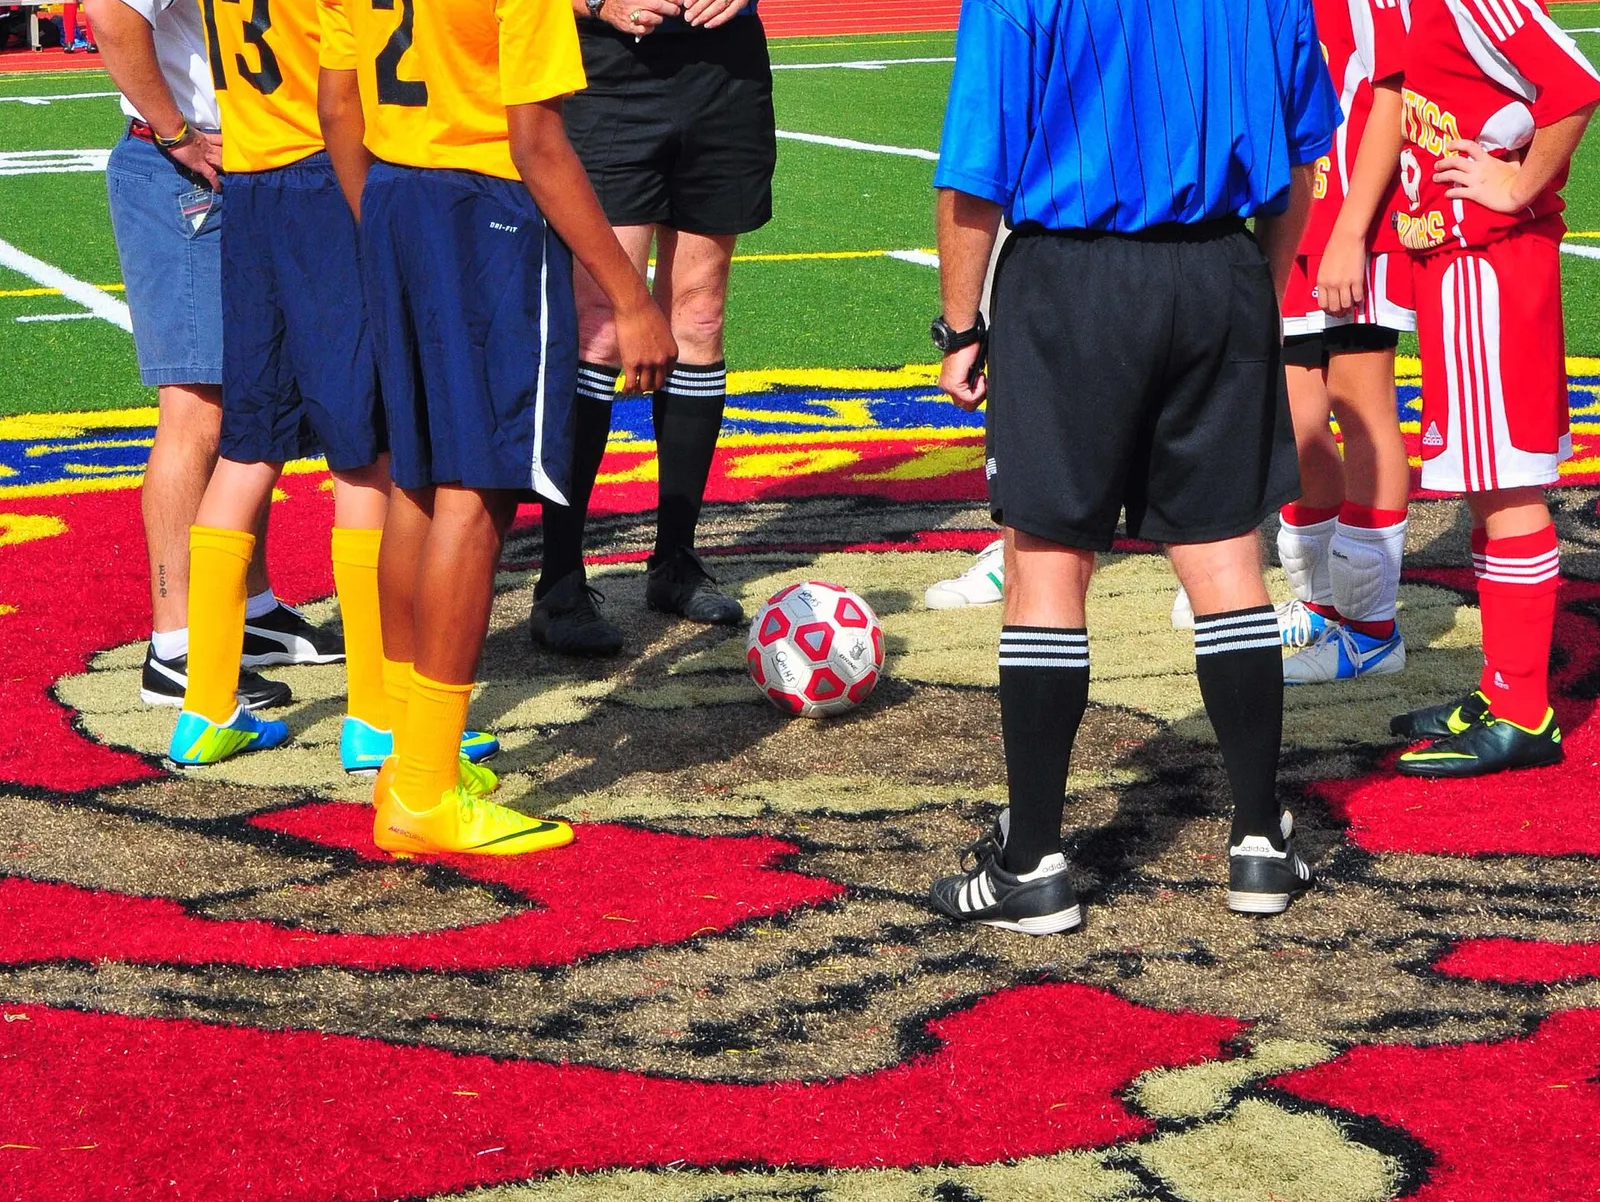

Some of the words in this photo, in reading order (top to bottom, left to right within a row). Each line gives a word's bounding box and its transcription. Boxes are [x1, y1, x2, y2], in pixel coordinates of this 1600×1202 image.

[1401, 87, 1462, 159] TICO
[489, 221, 518, 233] DRI-FIT
[1240, 845, 1270, 853] adidas
[1042, 861, 1067, 873] adida
